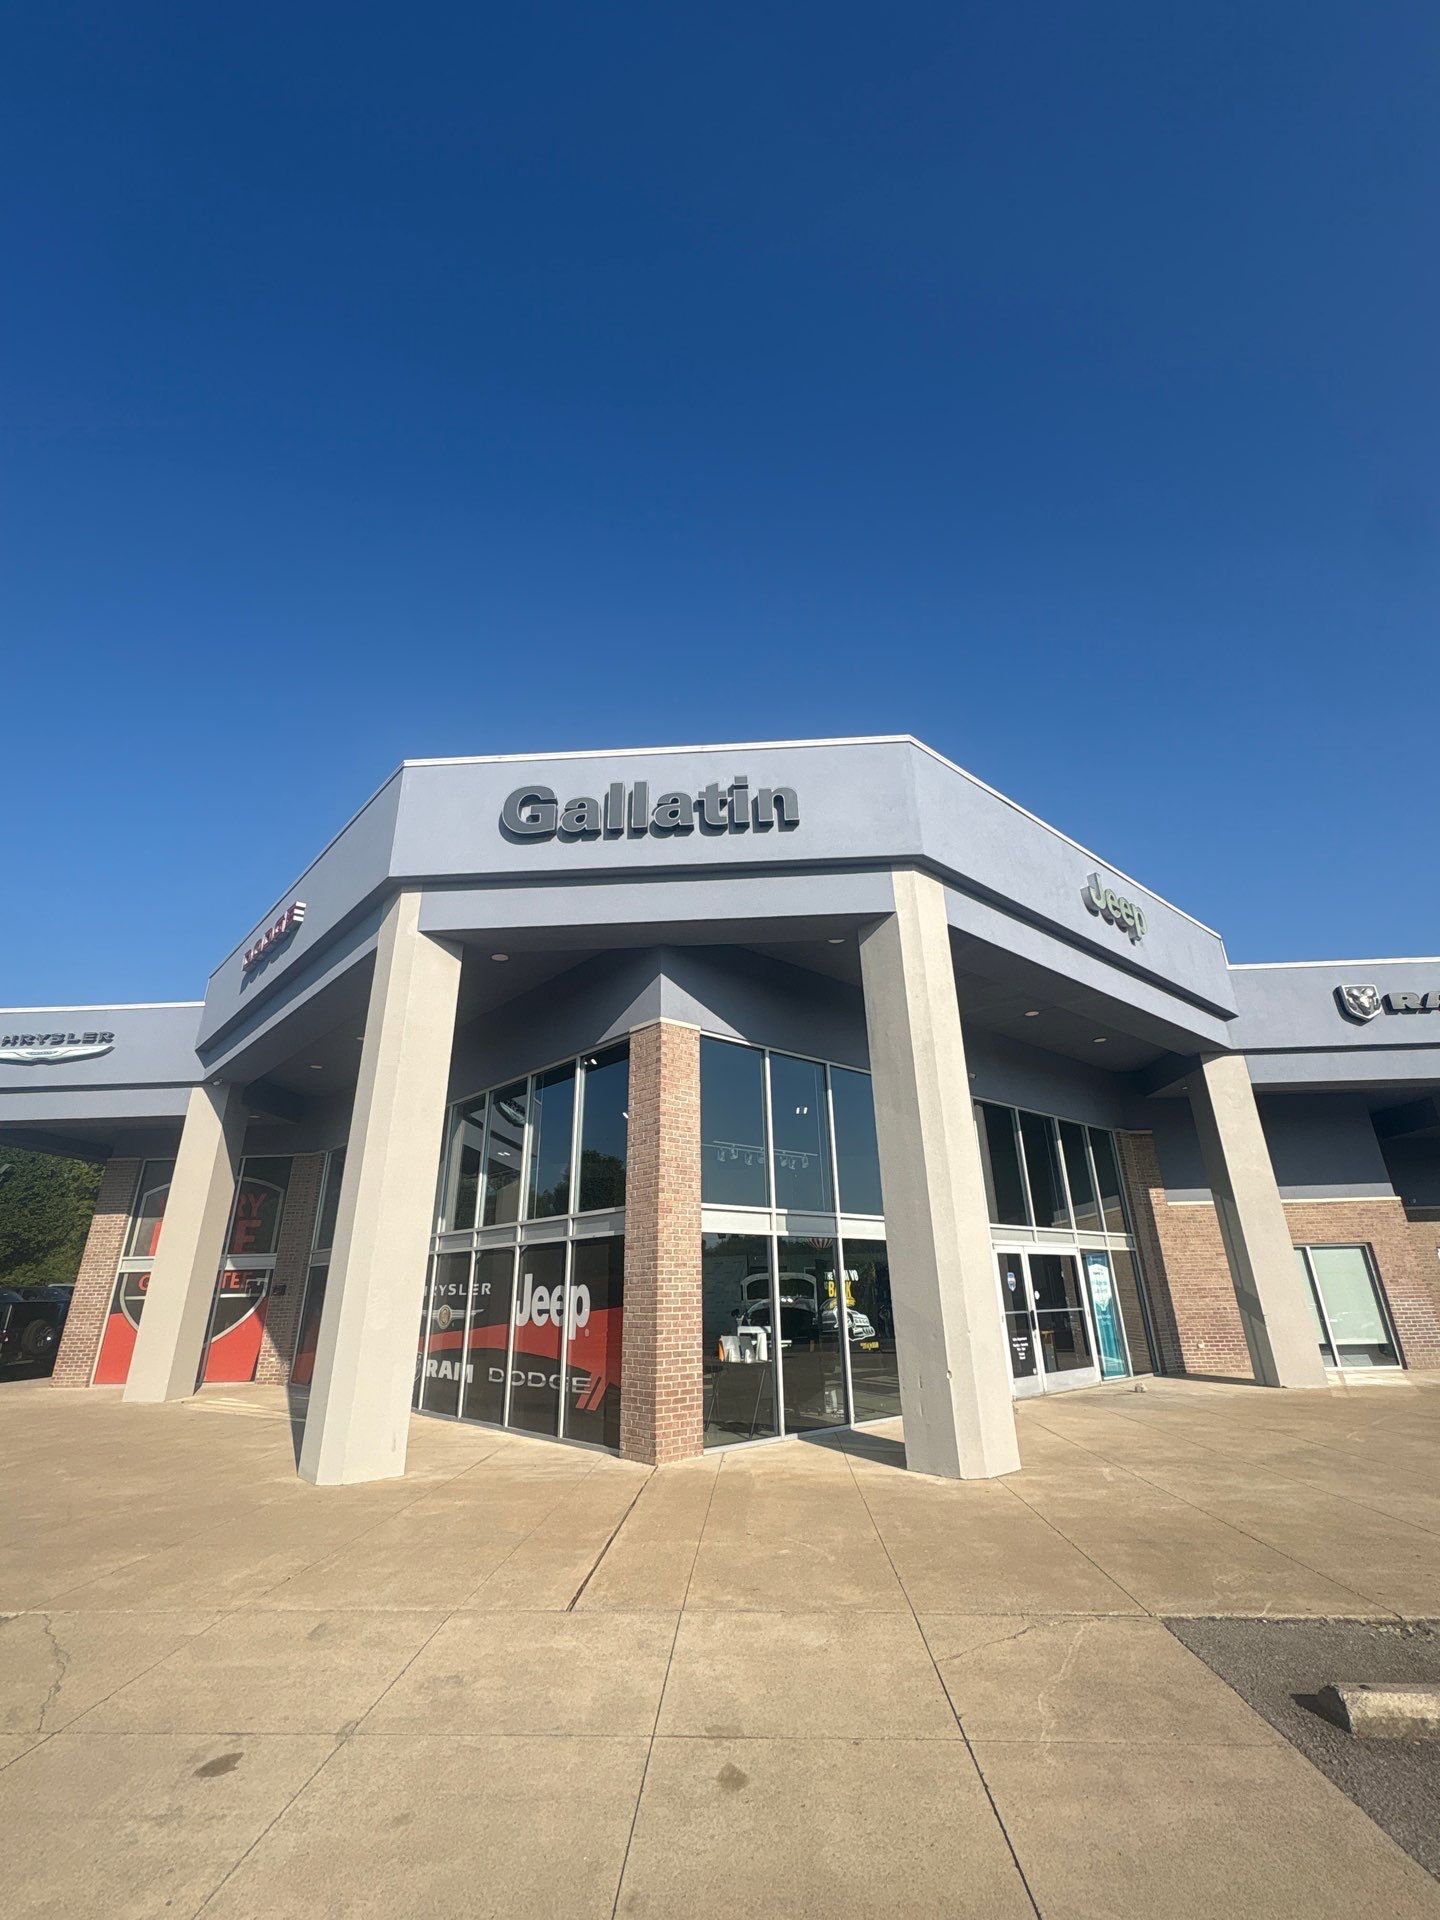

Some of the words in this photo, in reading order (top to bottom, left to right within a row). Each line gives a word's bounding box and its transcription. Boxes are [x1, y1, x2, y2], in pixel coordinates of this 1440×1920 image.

[500, 776, 800, 841] Gallatin
[1084, 872, 1147, 942] Jeep
[516, 1273, 590, 1340] Jeep
[828, 1281, 852, 1298] BK
[426, 1359, 474, 1384] RAM
[488, 1367, 592, 1394] DODGE
